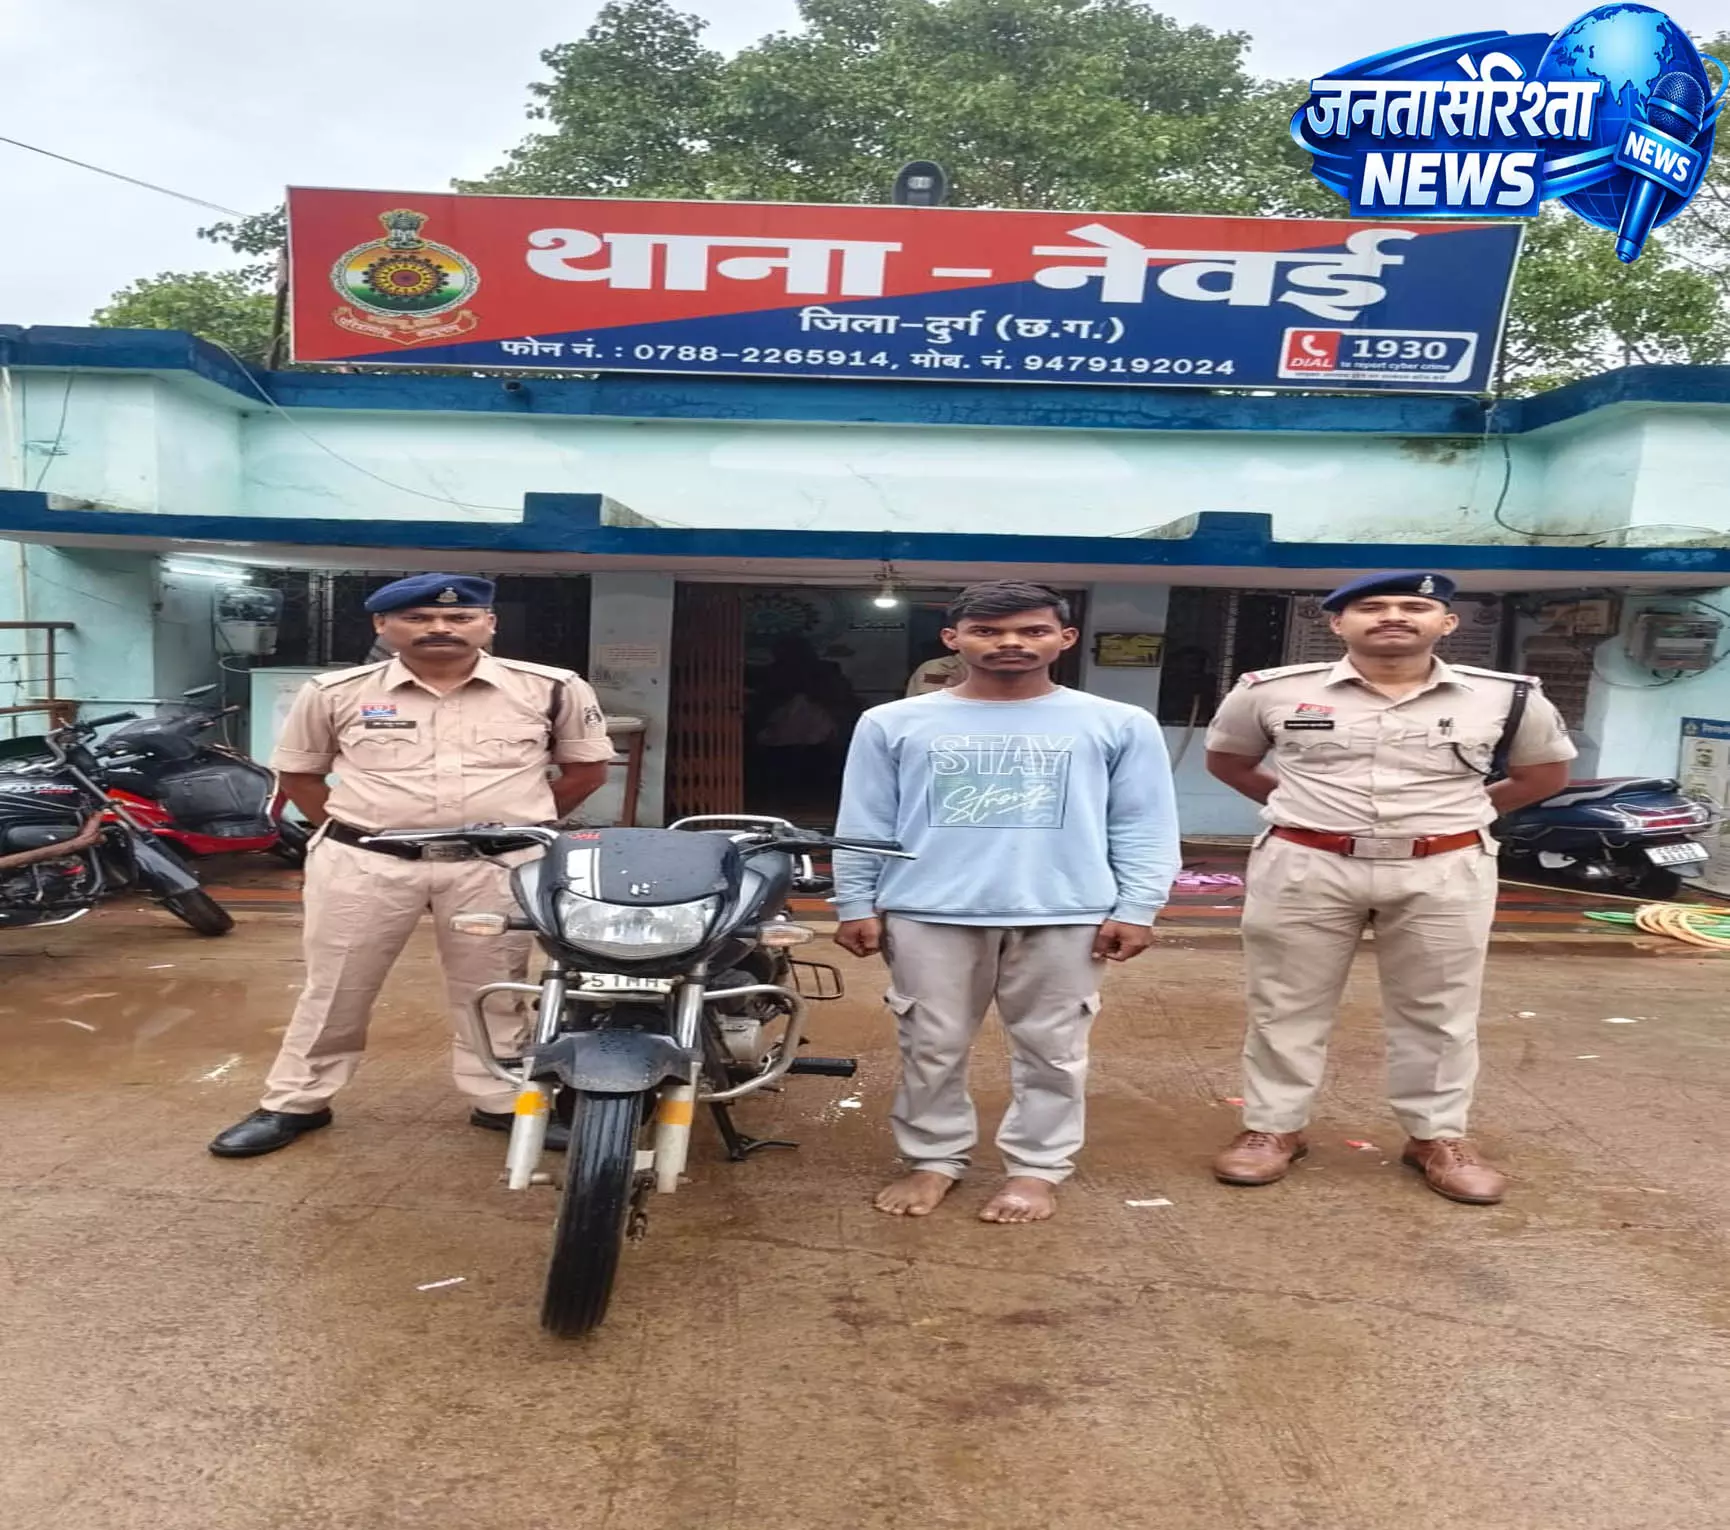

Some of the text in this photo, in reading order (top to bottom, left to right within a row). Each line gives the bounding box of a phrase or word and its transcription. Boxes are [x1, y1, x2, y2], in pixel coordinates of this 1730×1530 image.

[526, 228, 902, 296] थाना
[1032, 223, 1419, 321] नेवई
[996, 314, 1125, 343] (छ.ग.)
[500, 336, 564, 357] फोन
[634, 344, 899, 370] 0788-2265914,
[909, 348, 970, 369] मोब.
[980, 349, 1012, 370] नं.
[1024, 355, 1235, 375] 9479192024
[1289, 357, 1333, 368] DIAL
[1352, 339, 1447, 360] 1930
[931, 734, 1075, 775] STAY
